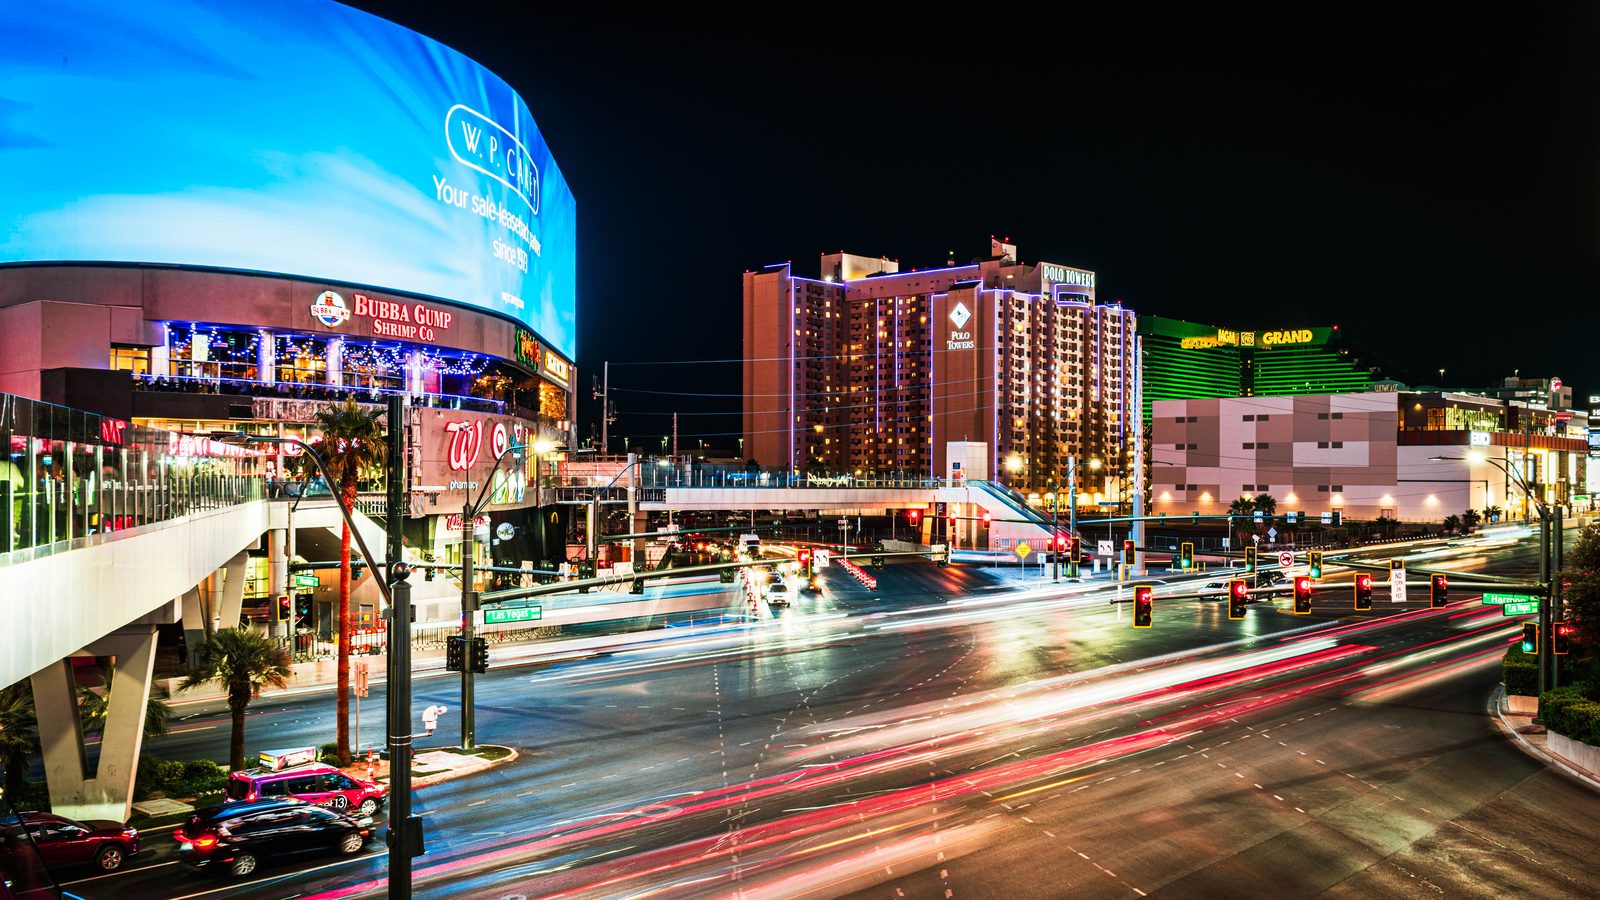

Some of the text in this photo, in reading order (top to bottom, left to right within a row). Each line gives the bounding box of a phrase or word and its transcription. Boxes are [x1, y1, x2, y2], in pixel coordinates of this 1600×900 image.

[507, 147, 537, 203] CAREY
[432, 174, 468, 208] Your
[493, 237, 516, 266] since
[1043, 265, 1095, 288] POLO TOWERS
[353, 294, 452, 329] BUBBA GUMP
[373, 319, 436, 342] SHRIMP CO.
[951, 331, 970, 341] POLO
[1218, 329, 1236, 344] MGM
[1262, 329, 1313, 345] GRAND
[947, 341, 974, 350] TOWERS
[1491, 595, 1527, 604] Harmon
[492, 610, 505, 620] Las
[506, 609, 529, 621] Vegas
[1508, 603, 1517, 613] Las
[1517, 602, 1531, 614] Vegas
[335, 797, 345, 808] 13
